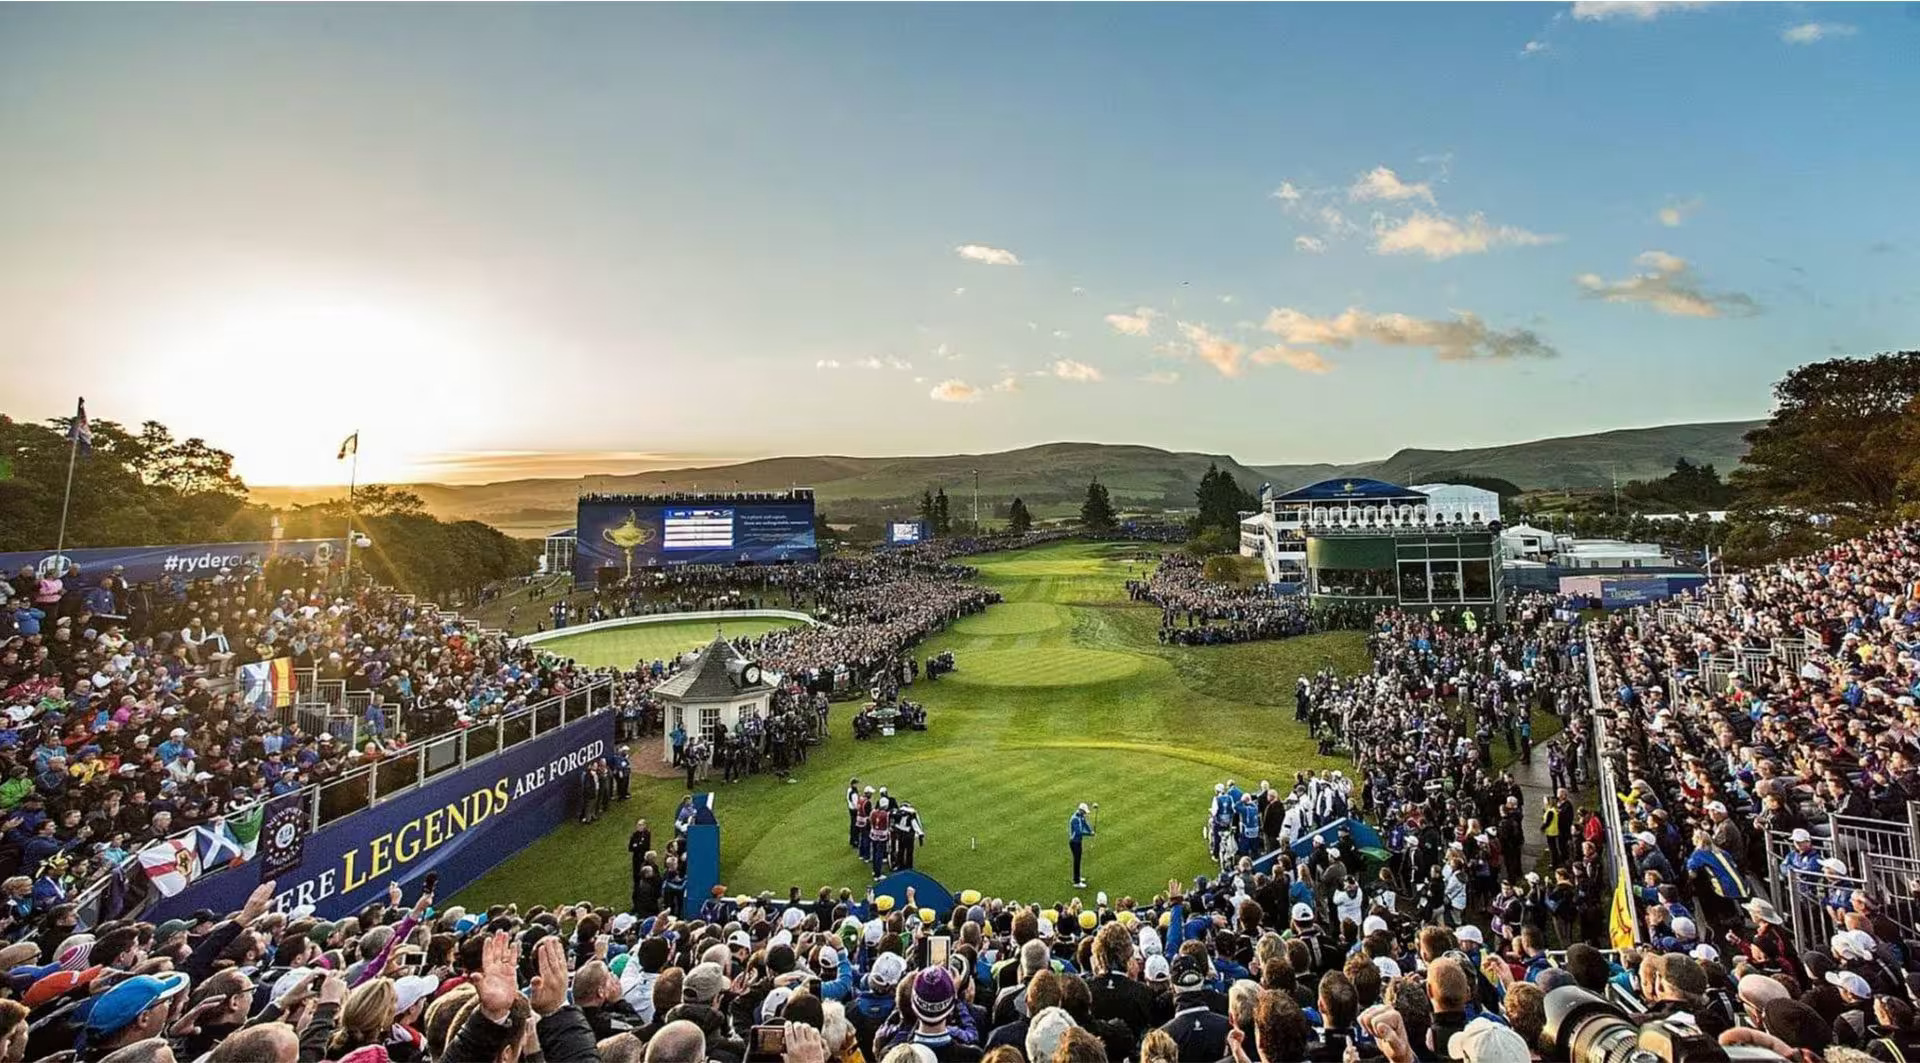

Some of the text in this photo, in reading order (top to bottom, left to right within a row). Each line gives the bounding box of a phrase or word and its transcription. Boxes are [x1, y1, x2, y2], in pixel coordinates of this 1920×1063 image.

[274, 868, 336, 914] ERE
[341, 777, 508, 894] LEGENDS
[513, 767, 546, 800] ARE
[549, 740, 604, 782] FORGED
